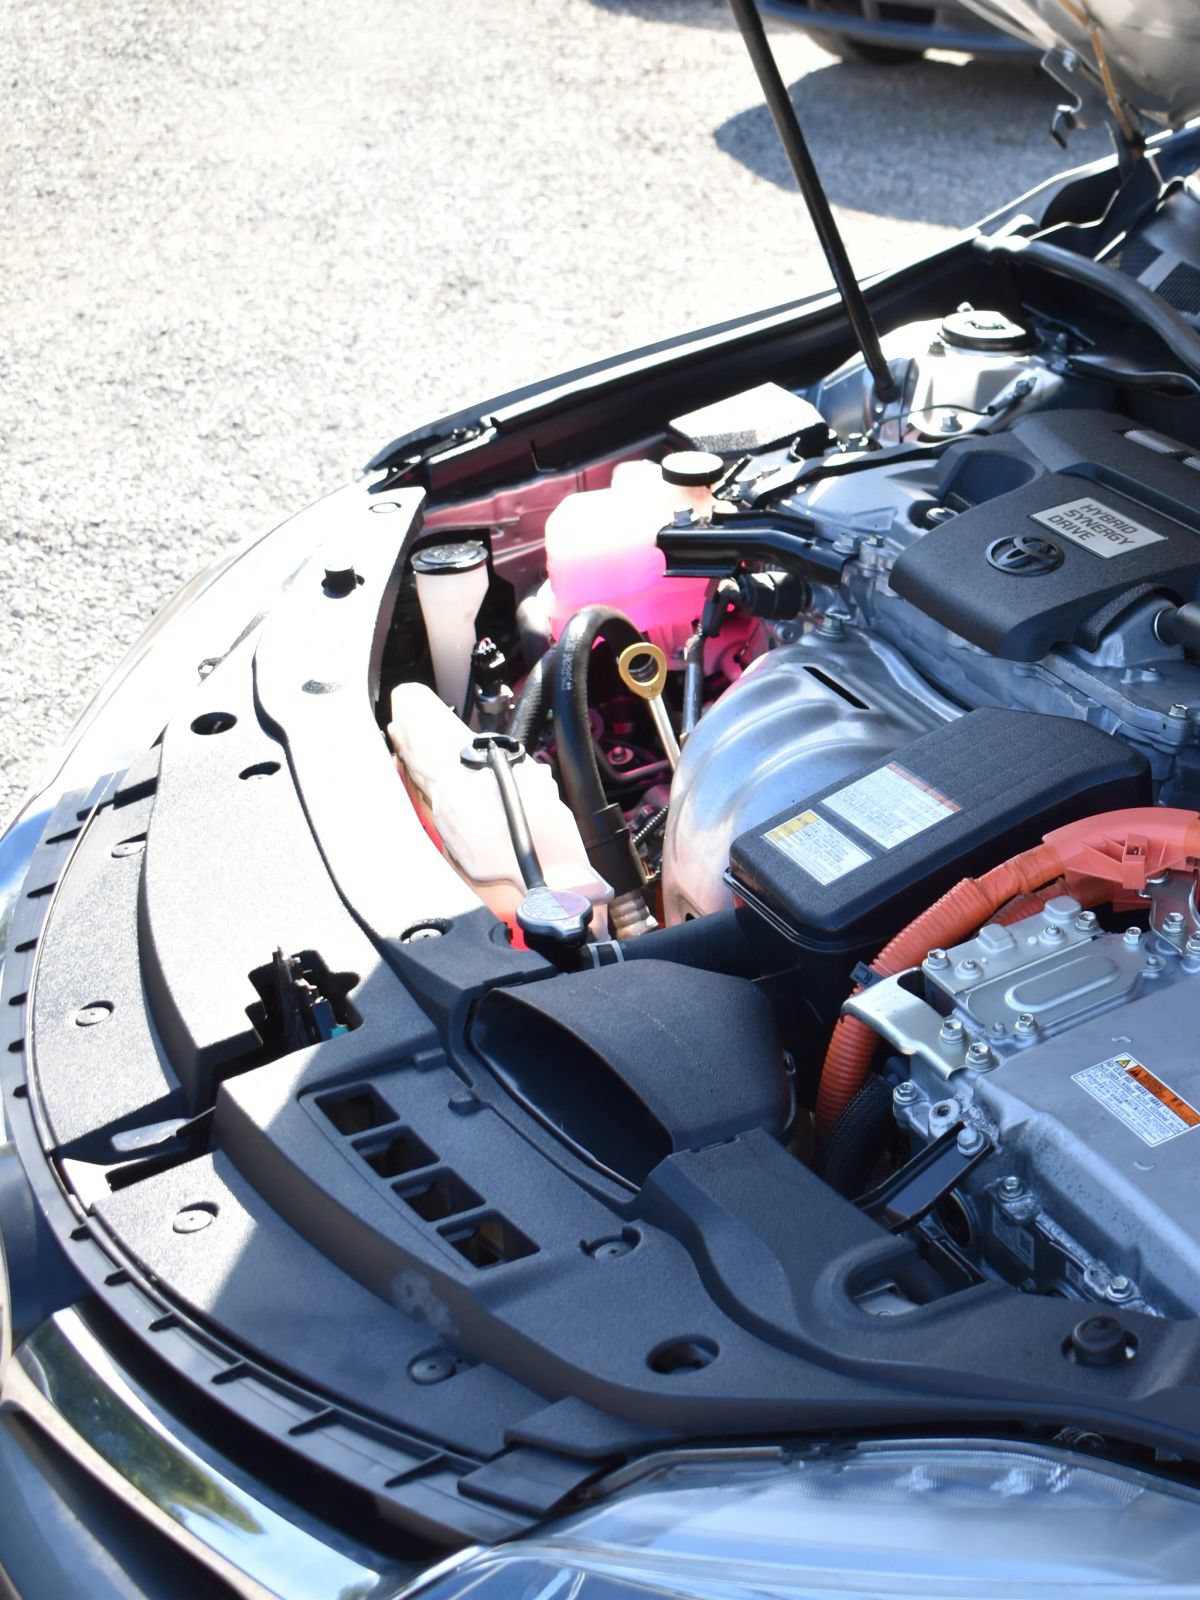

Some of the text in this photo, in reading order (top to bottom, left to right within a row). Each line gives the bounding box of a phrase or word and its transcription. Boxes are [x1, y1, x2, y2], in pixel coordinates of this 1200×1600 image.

[1047, 515, 1095, 541] DRIVE
[1063, 509, 1135, 545] SYNERGY
[1079, 504, 1137, 534] HYBRID
